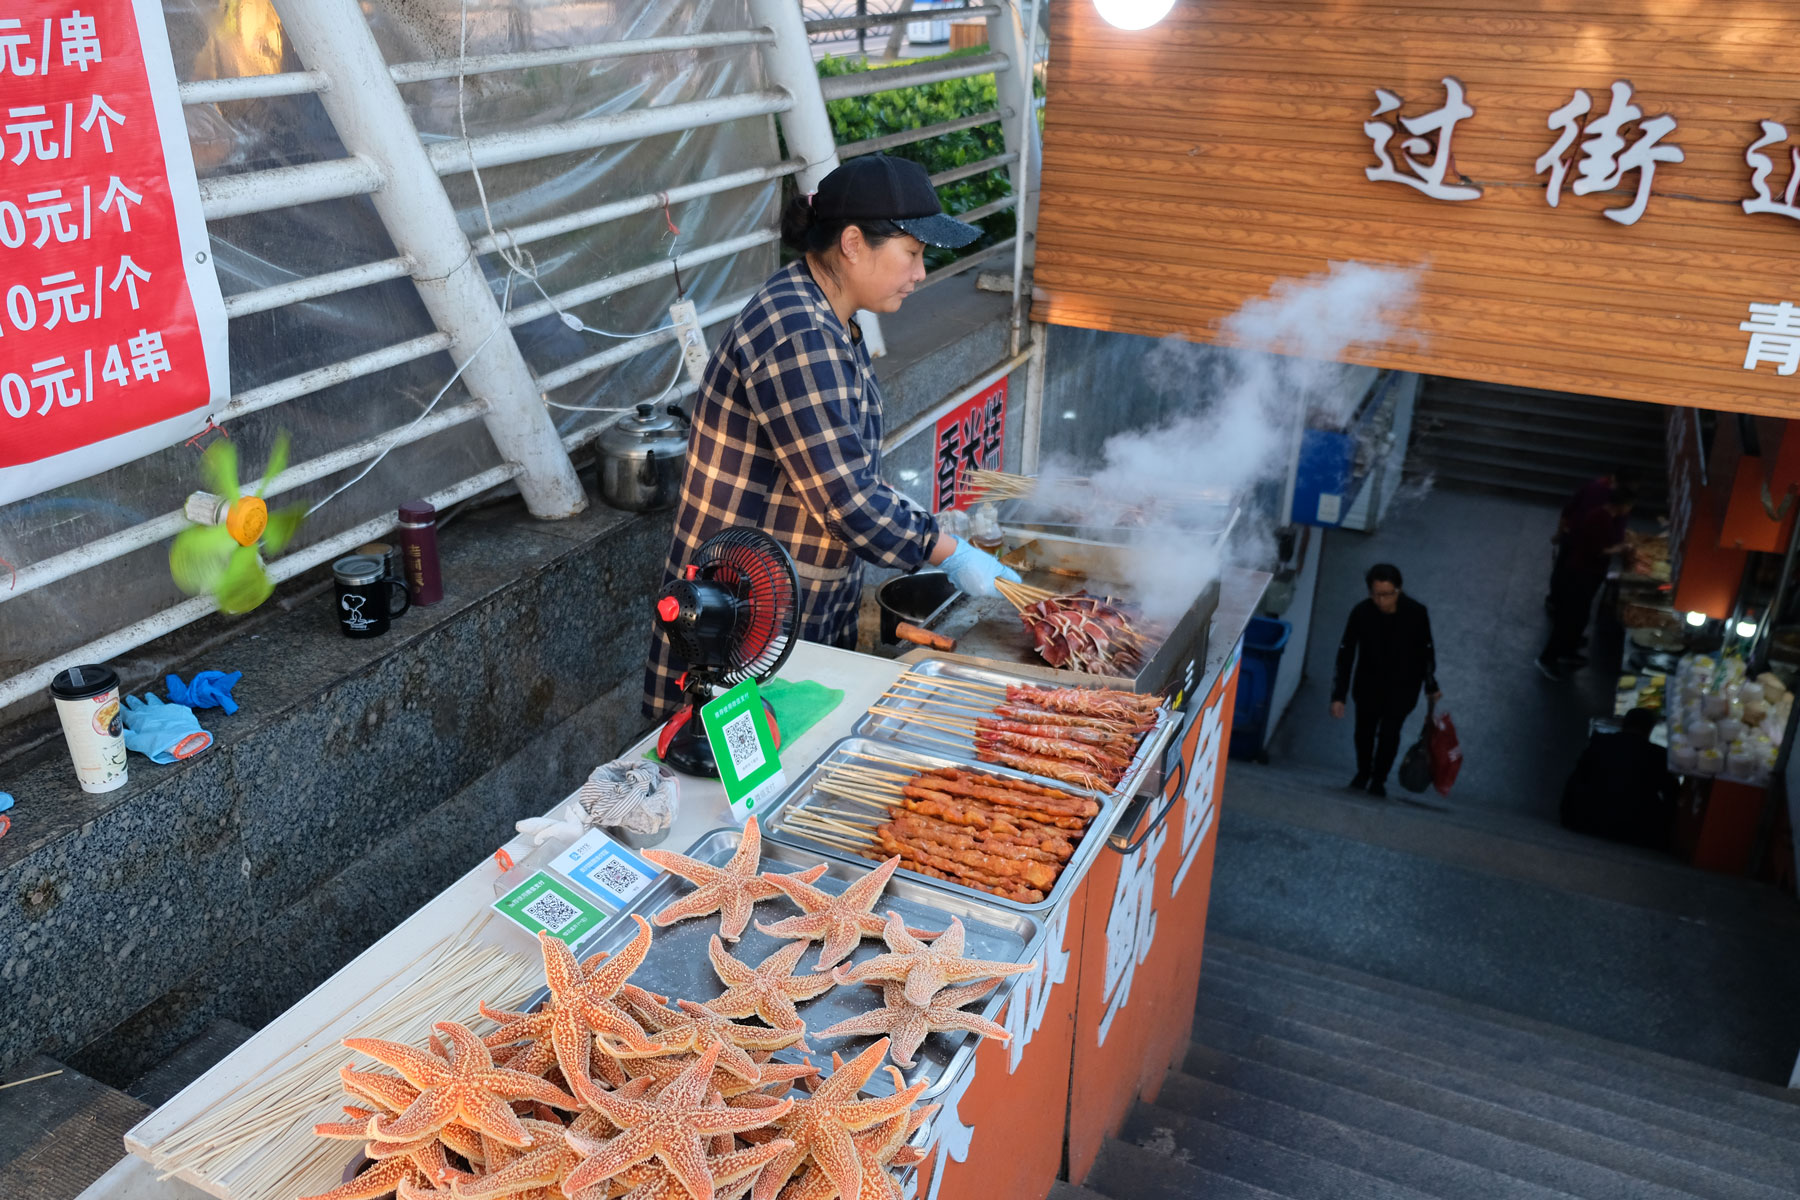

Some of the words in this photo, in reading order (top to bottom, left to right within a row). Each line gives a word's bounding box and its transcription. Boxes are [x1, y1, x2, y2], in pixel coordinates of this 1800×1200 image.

[0, 94, 126, 166] 元/个
[0, 255, 152, 337] 0元/个
[0, 328, 172, 419] 0元/4串
[1739, 301, 1800, 376] 青
